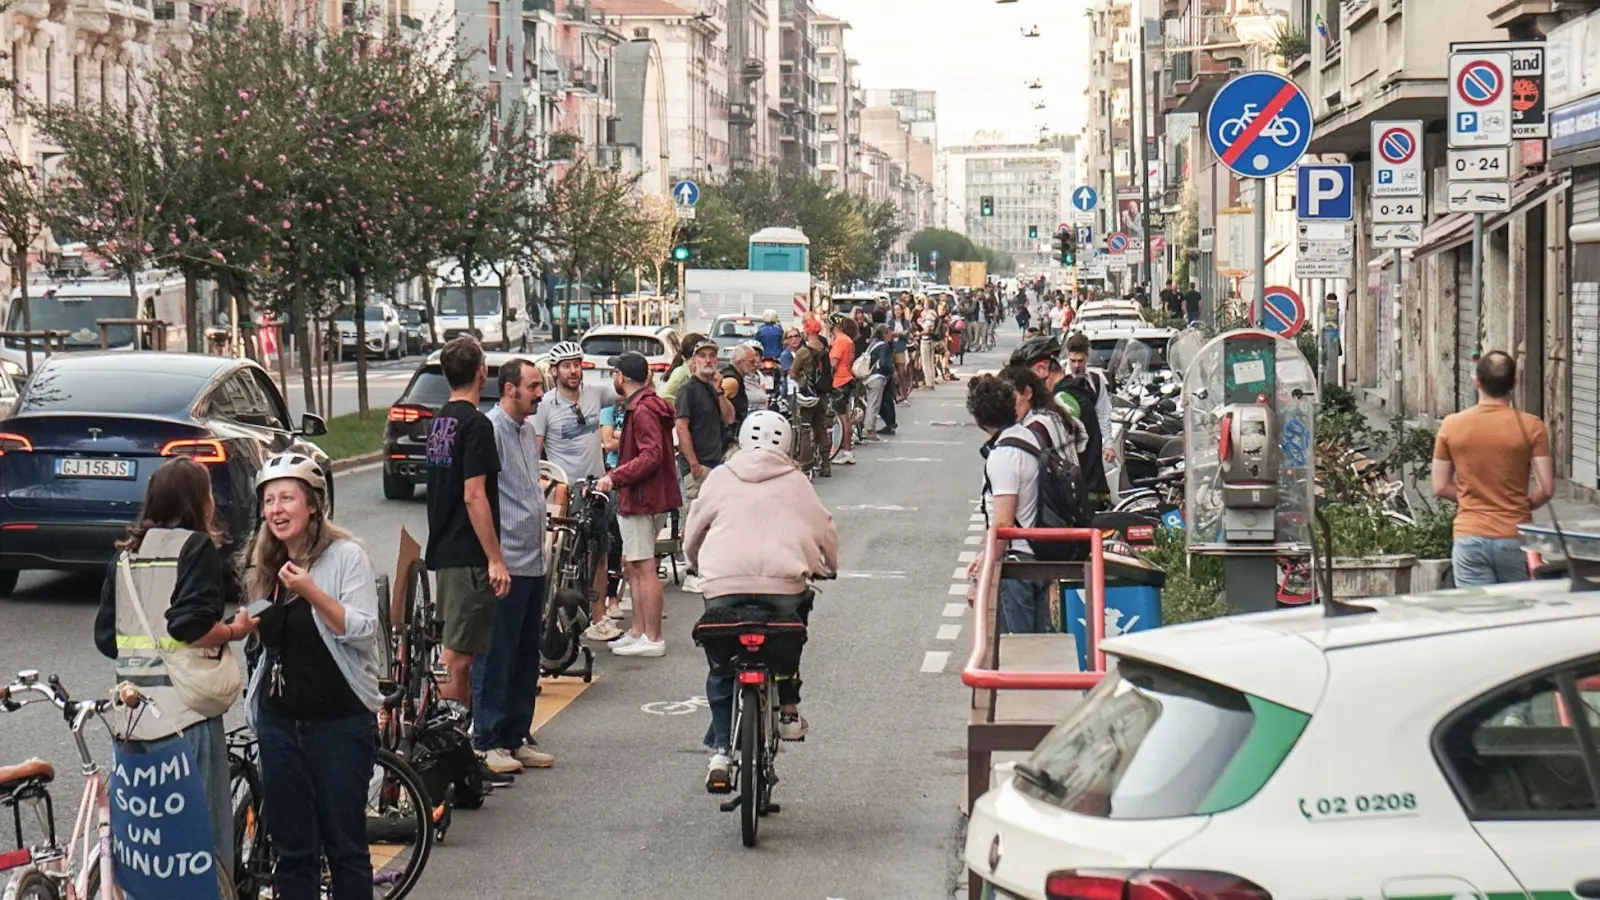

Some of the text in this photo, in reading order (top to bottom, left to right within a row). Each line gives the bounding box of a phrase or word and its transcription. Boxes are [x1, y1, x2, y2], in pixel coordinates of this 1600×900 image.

[1460, 114, 1474, 131] P
[1381, 171, 1390, 183] P
[1308, 169, 1344, 215] P
[1377, 185, 1418, 193] ciclomotori
[63, 460, 127, 475] GJ 156JS
[115, 788, 185, 818] SOLO
[1316, 792, 1417, 815] 02 0208
[127, 823, 161, 845] UN
[113, 834, 213, 879] MINUTO
